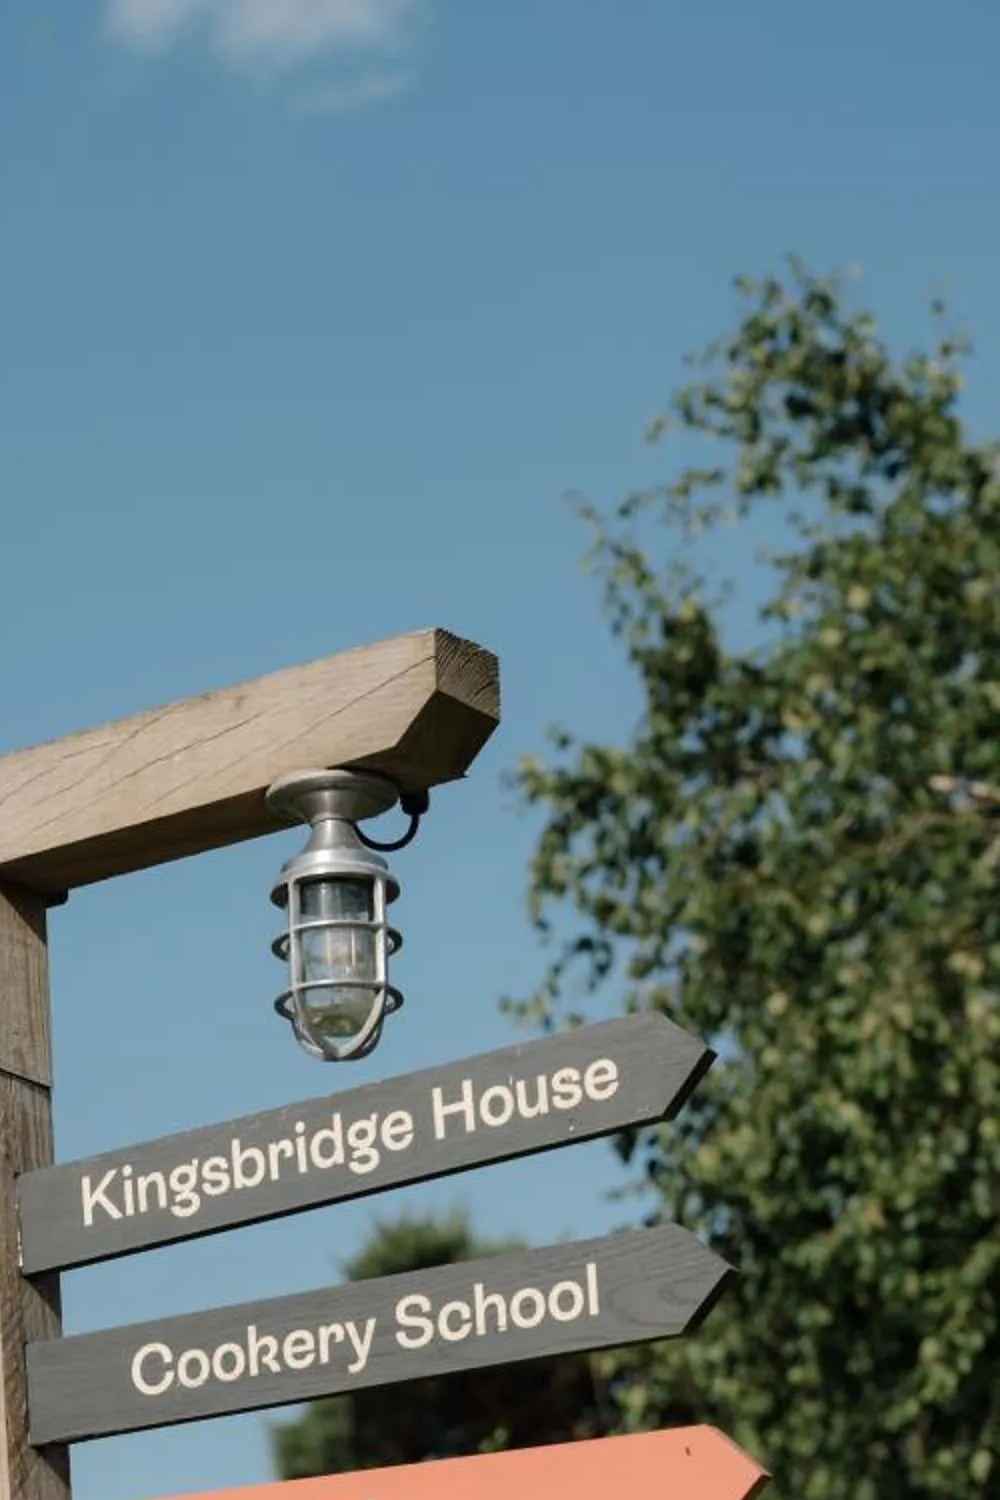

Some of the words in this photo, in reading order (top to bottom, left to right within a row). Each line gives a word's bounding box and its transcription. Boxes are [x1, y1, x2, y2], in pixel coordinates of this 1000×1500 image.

[81, 1107, 414, 1226] Kingsbridge
[432, 1058, 619, 1141] House
[130, 1317, 377, 1396] Cookery
[395, 1262, 600, 1349] School
